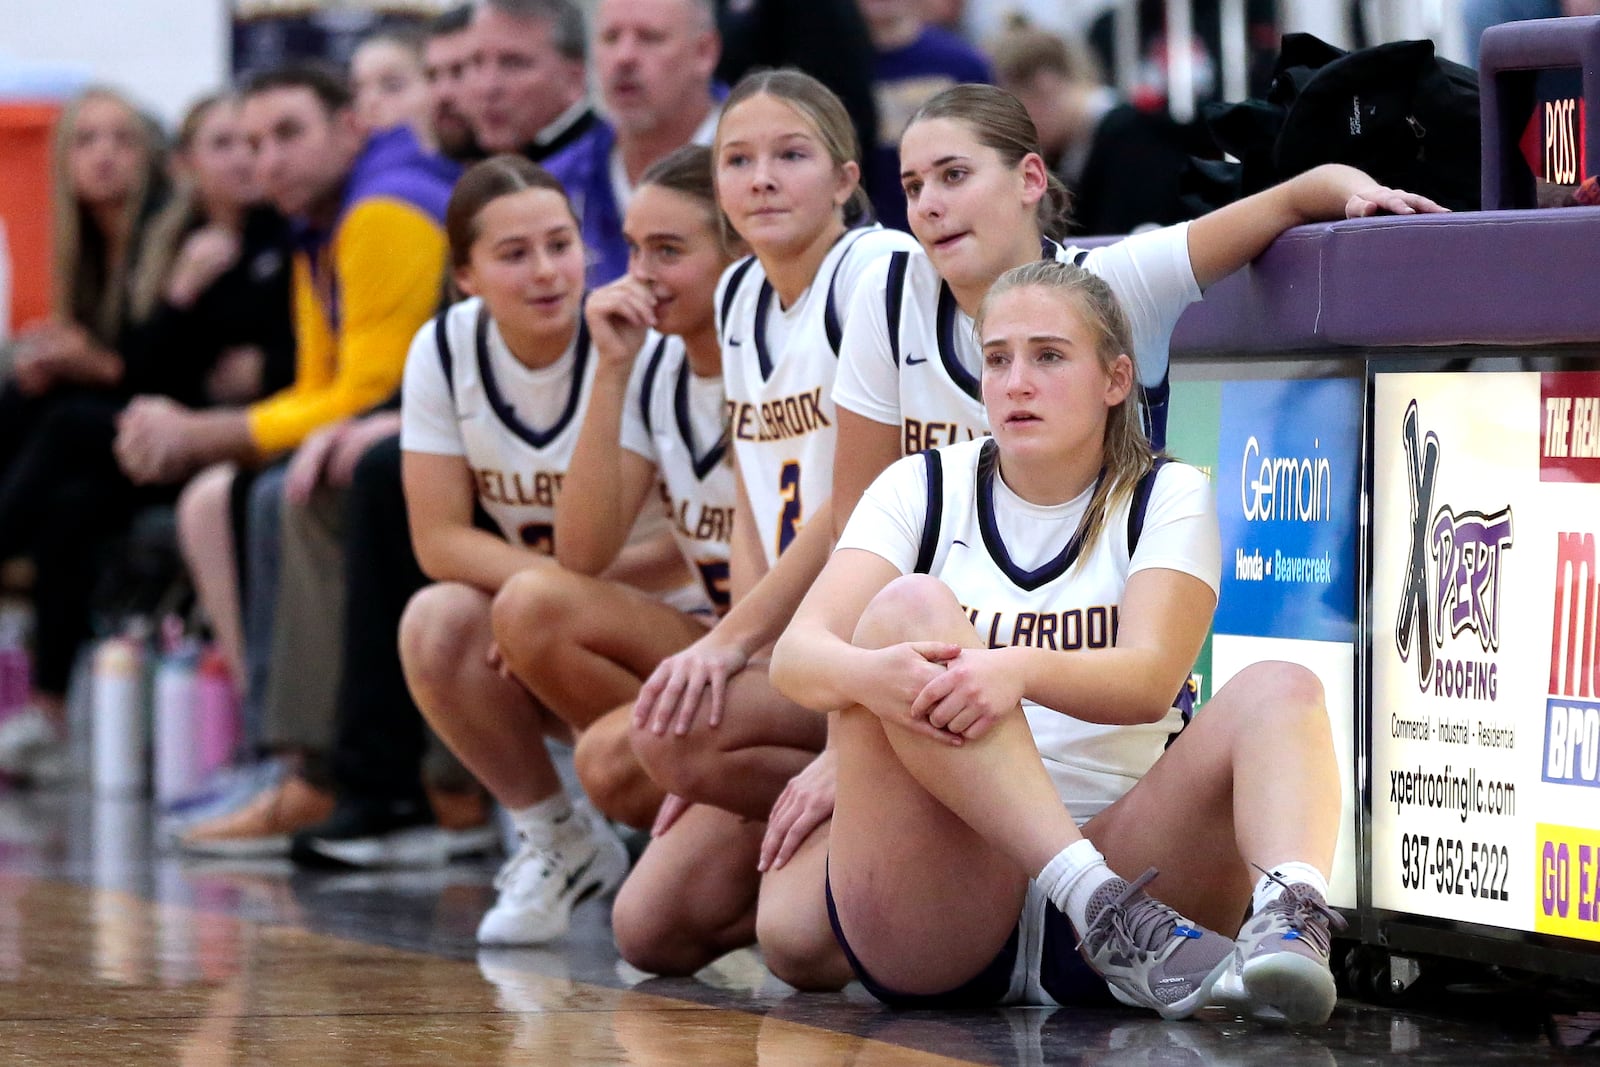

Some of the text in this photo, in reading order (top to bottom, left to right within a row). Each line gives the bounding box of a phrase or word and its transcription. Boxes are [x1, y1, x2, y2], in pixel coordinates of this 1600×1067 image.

[1545, 98, 1576, 185] POSS
[1544, 397, 1600, 459] THE REA
[1241, 435, 1331, 522] Germain
[1235, 547, 1332, 583] Honda of Beavercreek
[1435, 659, 1498, 702] ROOFING
[1391, 711, 1430, 741] Commercial
[1438, 716, 1469, 745] Industrial
[1478, 720, 1515, 749] Residential
[1389, 764, 1516, 823] xpertroofingllc.com
[1401, 832, 1509, 902] 937-952-5222
[1542, 841, 1570, 918] GO
